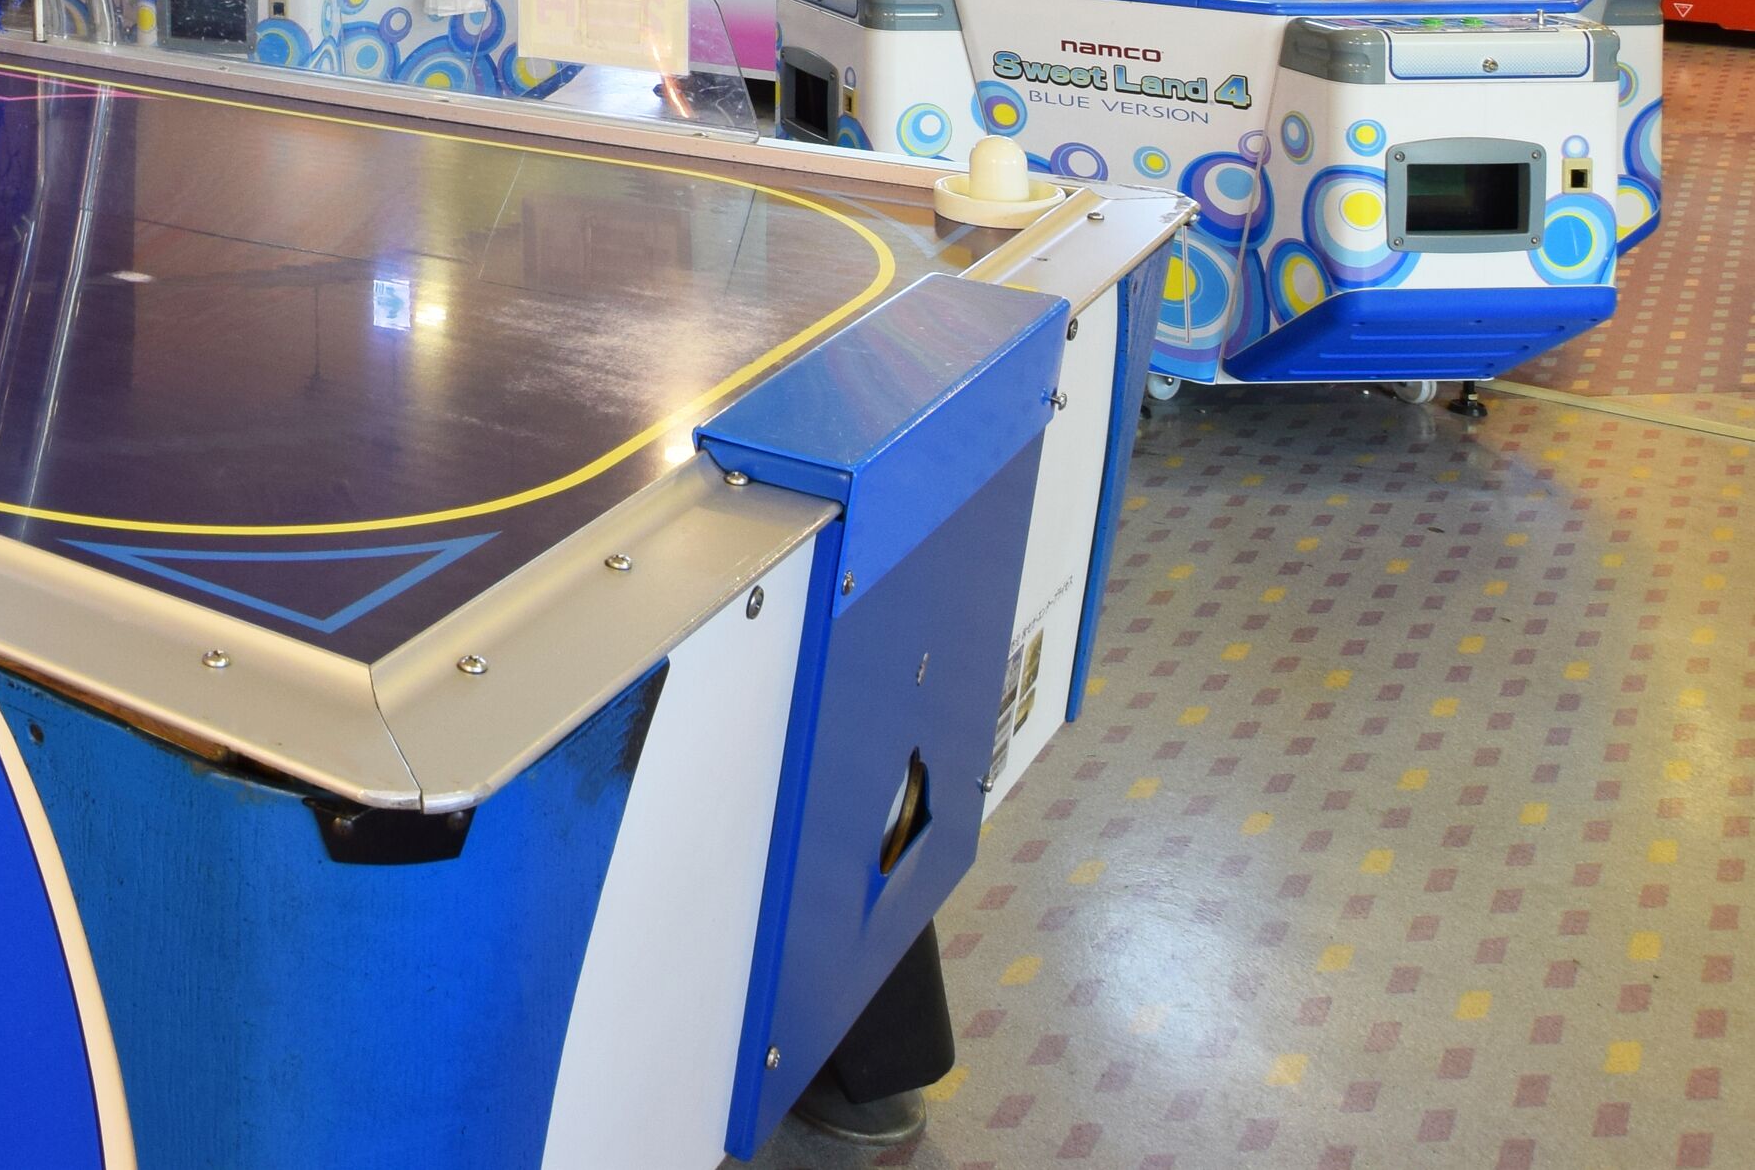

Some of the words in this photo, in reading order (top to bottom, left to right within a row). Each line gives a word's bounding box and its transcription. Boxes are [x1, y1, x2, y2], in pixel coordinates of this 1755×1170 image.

[1061, 39, 1161, 62] namco
[993, 50, 1108, 91] Sweet
[1113, 64, 1208, 103] Land
[1214, 74, 1252, 110] 4
[1029, 90, 1091, 109] BLUE
[1101, 98, 1209, 124] VERSION
